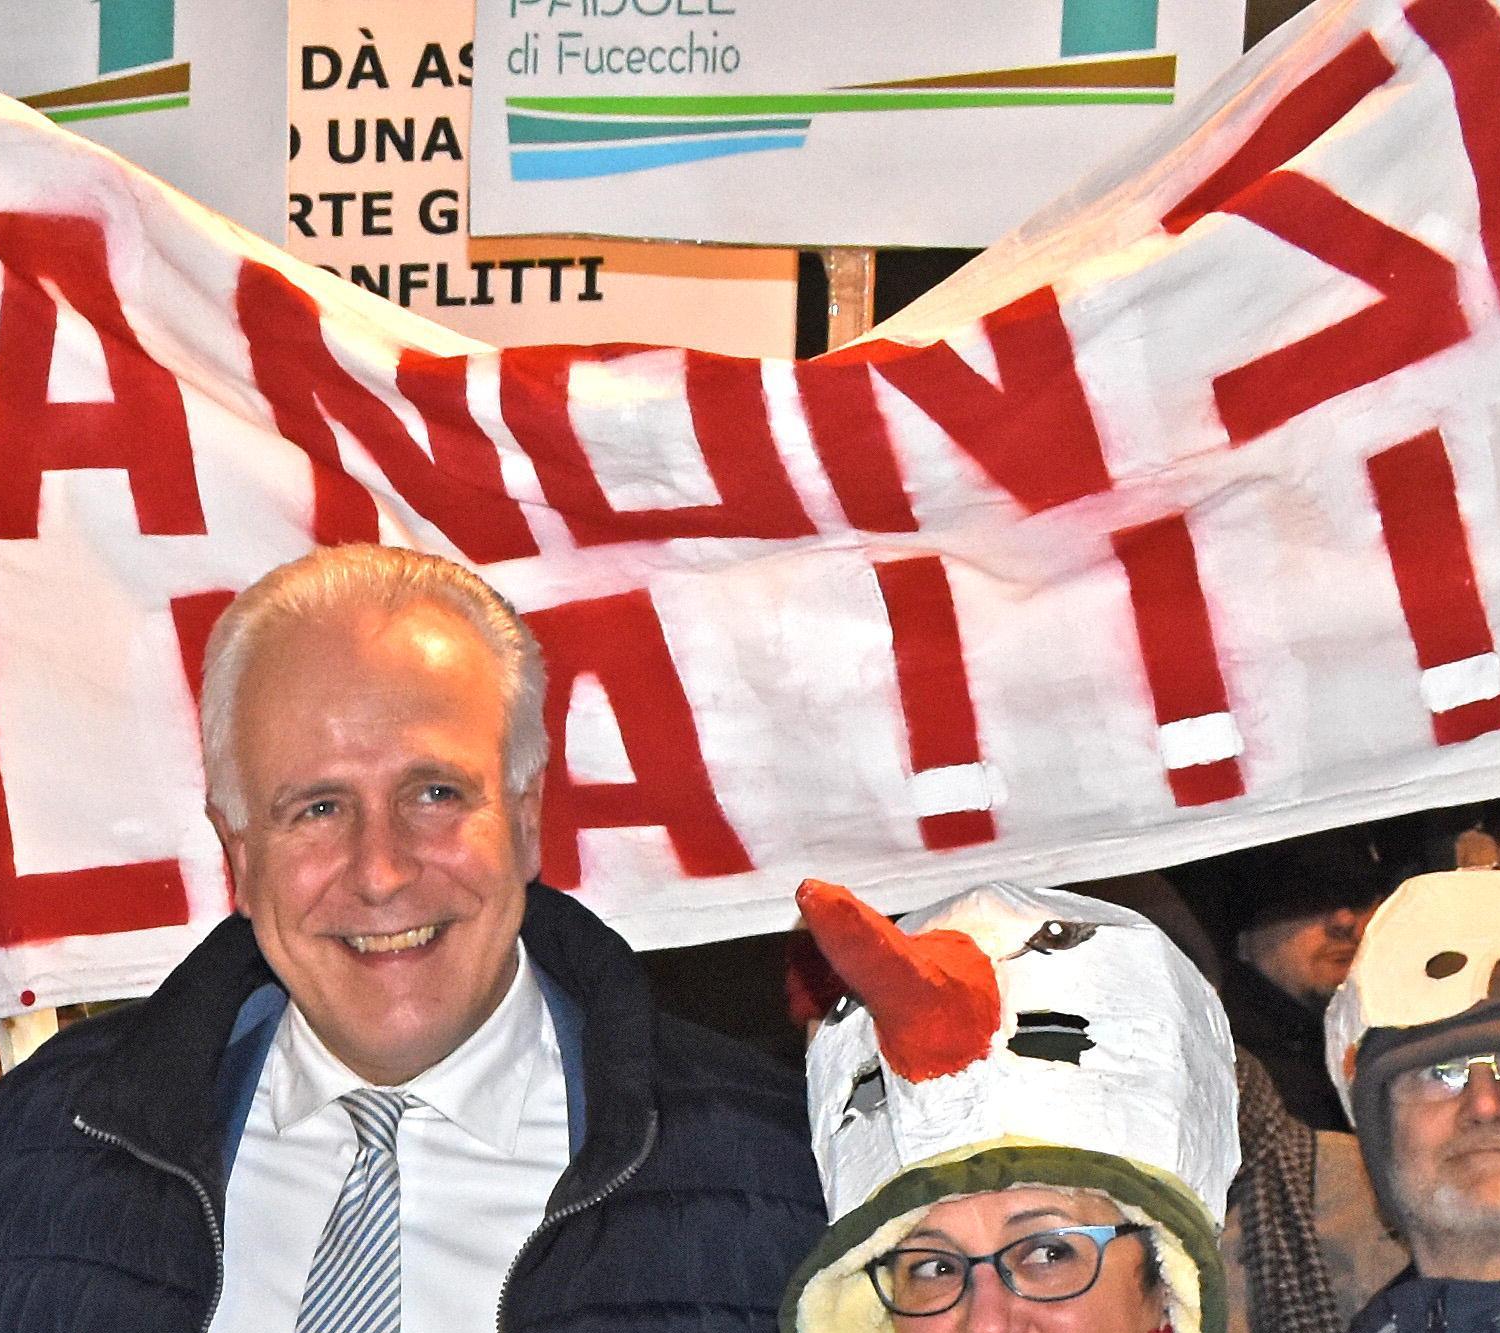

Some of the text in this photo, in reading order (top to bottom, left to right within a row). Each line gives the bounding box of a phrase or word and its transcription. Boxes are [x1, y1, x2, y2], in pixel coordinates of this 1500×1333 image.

[302, 27, 390, 90] DÀ
[507, 30, 742, 74] di Fucecchio
[328, 117, 464, 163] UNA
[235, 256, 1112, 562] NON
